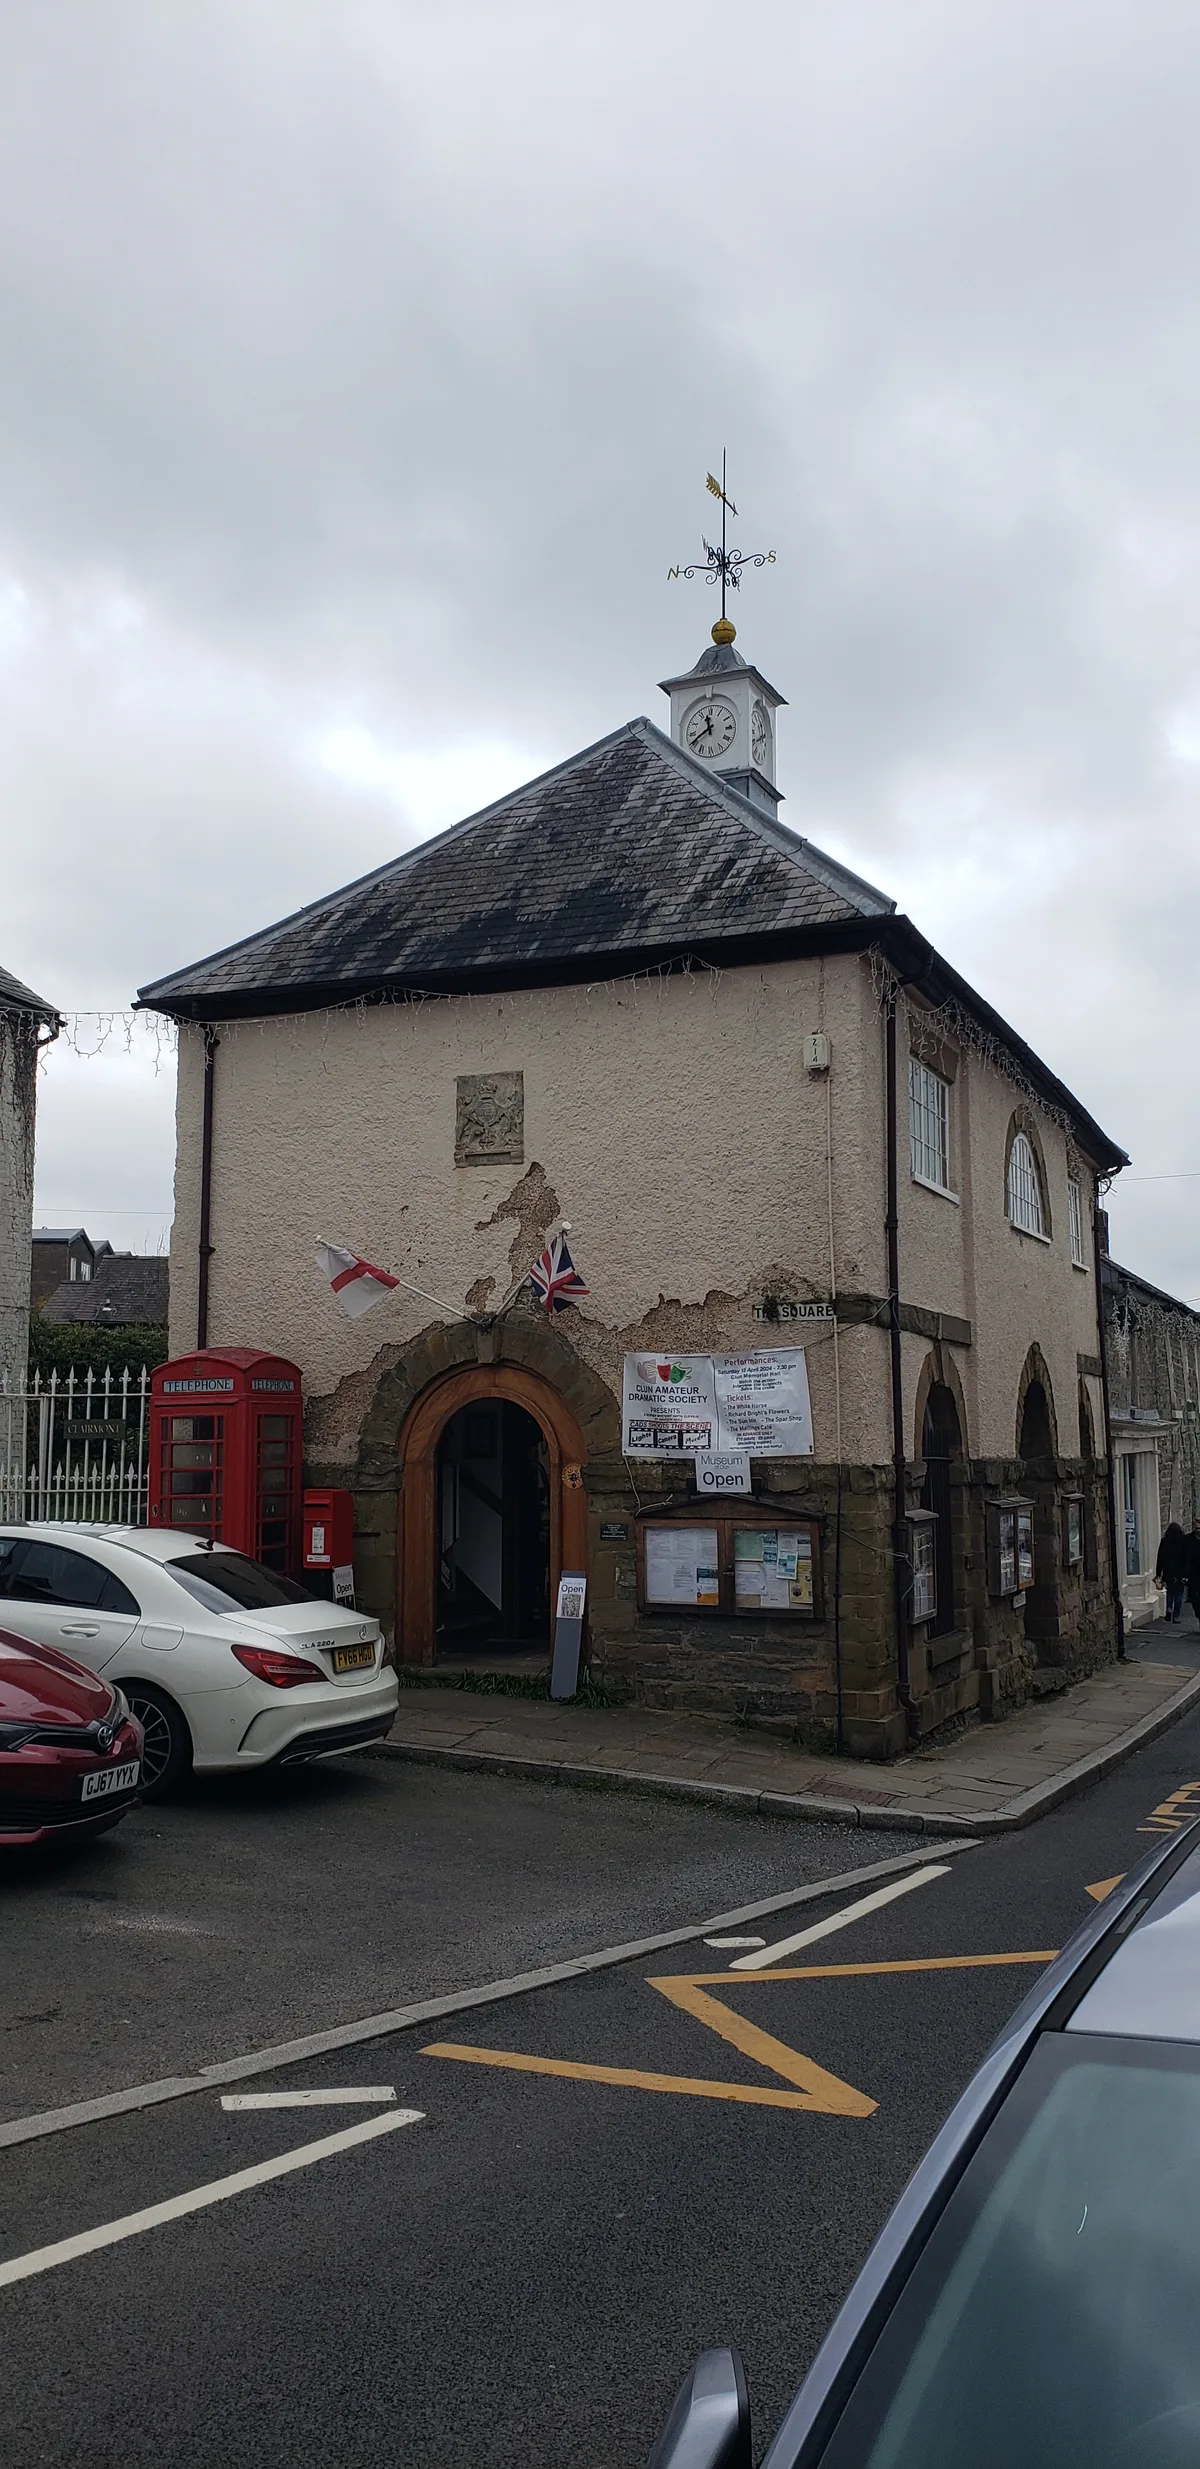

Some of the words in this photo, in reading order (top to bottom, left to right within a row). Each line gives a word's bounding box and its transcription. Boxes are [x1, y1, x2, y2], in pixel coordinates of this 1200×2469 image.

[768, 550, 777, 563] S
[667, 565, 680, 581] N
[782, 1306, 834, 1318] SQUARE
[724, 1357, 778, 1366] Performances:
[166, 1380, 232, 1392] TELEPHONE
[253, 1380, 293, 1390] TELEPHONE
[636, 1385, 654, 1393] CLUN
[655, 1386, 699, 1394] AMATEUR
[629, 1393, 666, 1403] DRAMATIC
[669, 1395, 708, 1404] SOCIETY
[726, 1395, 753, 1403] Tickets:
[632, 1432, 652, 1443] Lights
[658, 1435, 677, 1444] Camera
[685, 1433, 706, 1444] Murder
[701, 1455, 743, 1465] Museum
[703, 1472, 744, 1488] Open
[337, 1583, 352, 1594] Open
[561, 1584, 584, 1594] Open
[337, 1650, 358, 1667] FY66
[358, 1647, 372, 1663] HGD
[87, 1771, 114, 1795] GJ67
[116, 1765, 135, 1787] YYX
